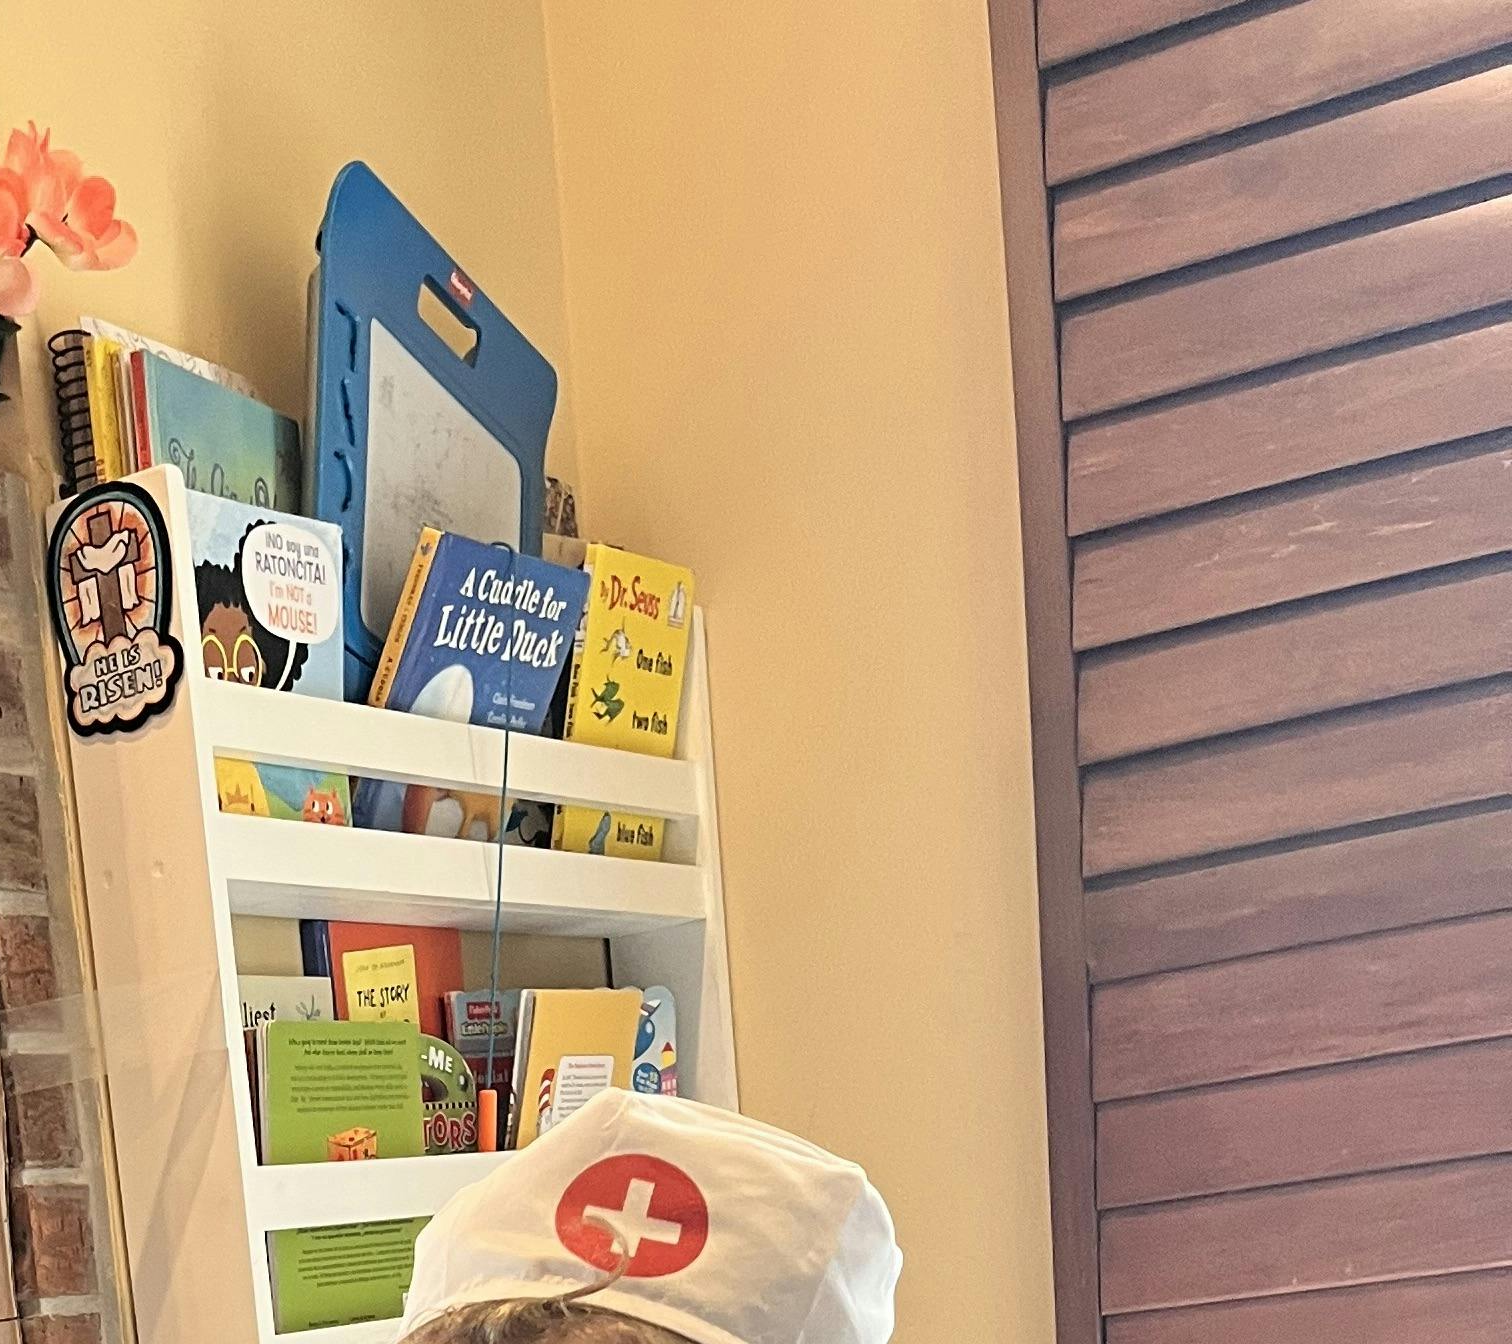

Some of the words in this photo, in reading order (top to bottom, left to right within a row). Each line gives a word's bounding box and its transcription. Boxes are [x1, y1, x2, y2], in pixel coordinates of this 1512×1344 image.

[255, 551, 326, 585] RATONCITA!
[286, 584, 304, 603] NOT
[459, 567, 476, 598] A
[477, 569, 541, 614] Cuddle
[538, 586, 567, 622] for
[609, 575, 628, 612] Dr.
[630, 575, 661, 620] Seuss
[268, 602, 317, 635] MOUSE!
[433, 605, 505, 656] Little
[500, 619, 564, 668] Duck
[94, 653, 119, 678] HE
[120, 643, 141, 668] IS
[79, 659, 163, 714] RISEN!
[357, 988, 376, 1007] THE
[379, 984, 410, 1007] STORY
